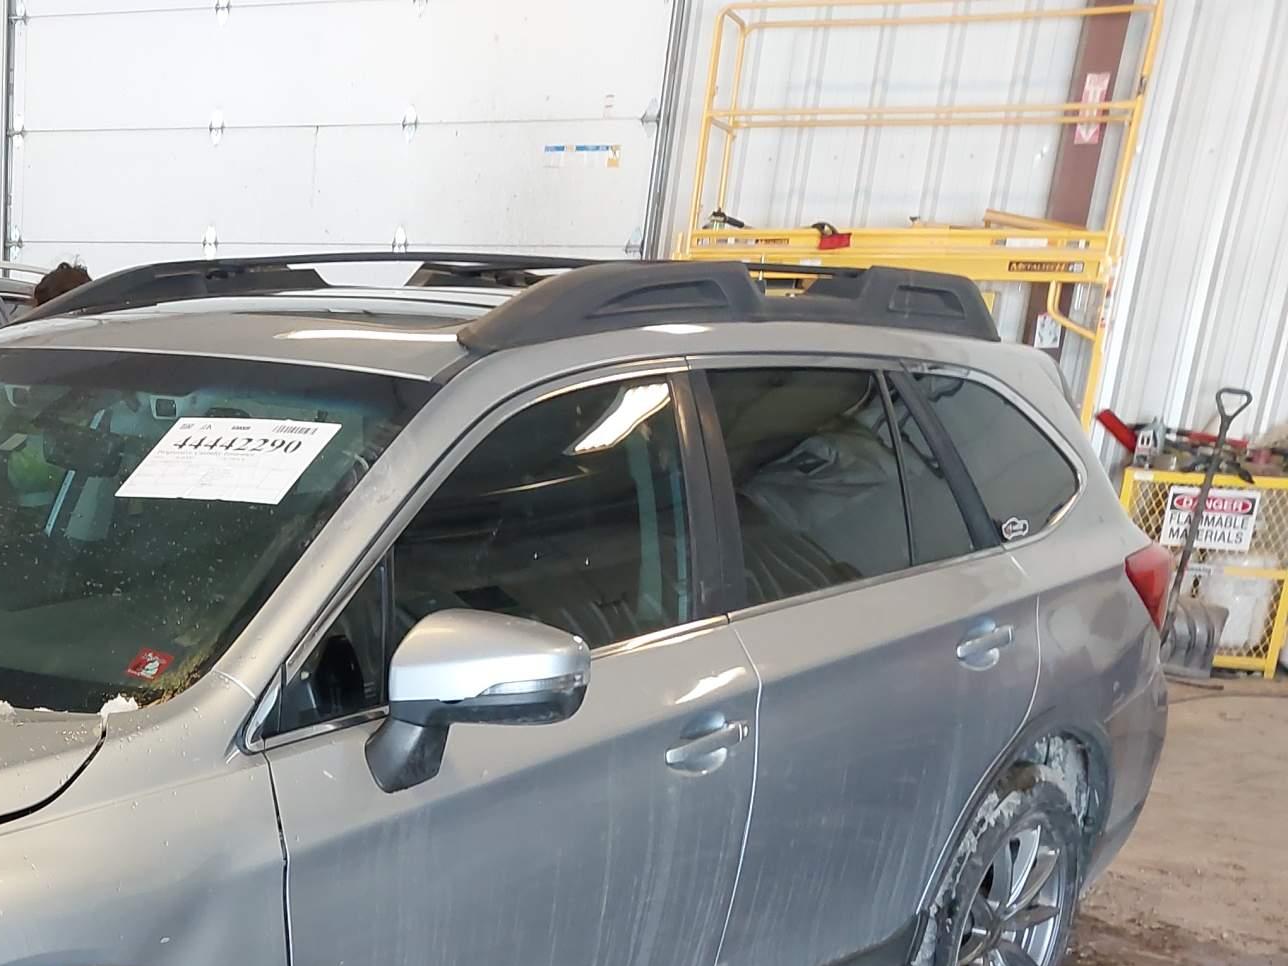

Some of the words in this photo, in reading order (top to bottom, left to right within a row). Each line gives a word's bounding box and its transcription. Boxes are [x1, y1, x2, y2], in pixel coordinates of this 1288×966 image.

[173, 435, 303, 454] 44442290
[1169, 513, 1249, 530] FLAMABLE
[1168, 527, 1244, 544] MAERIALS
